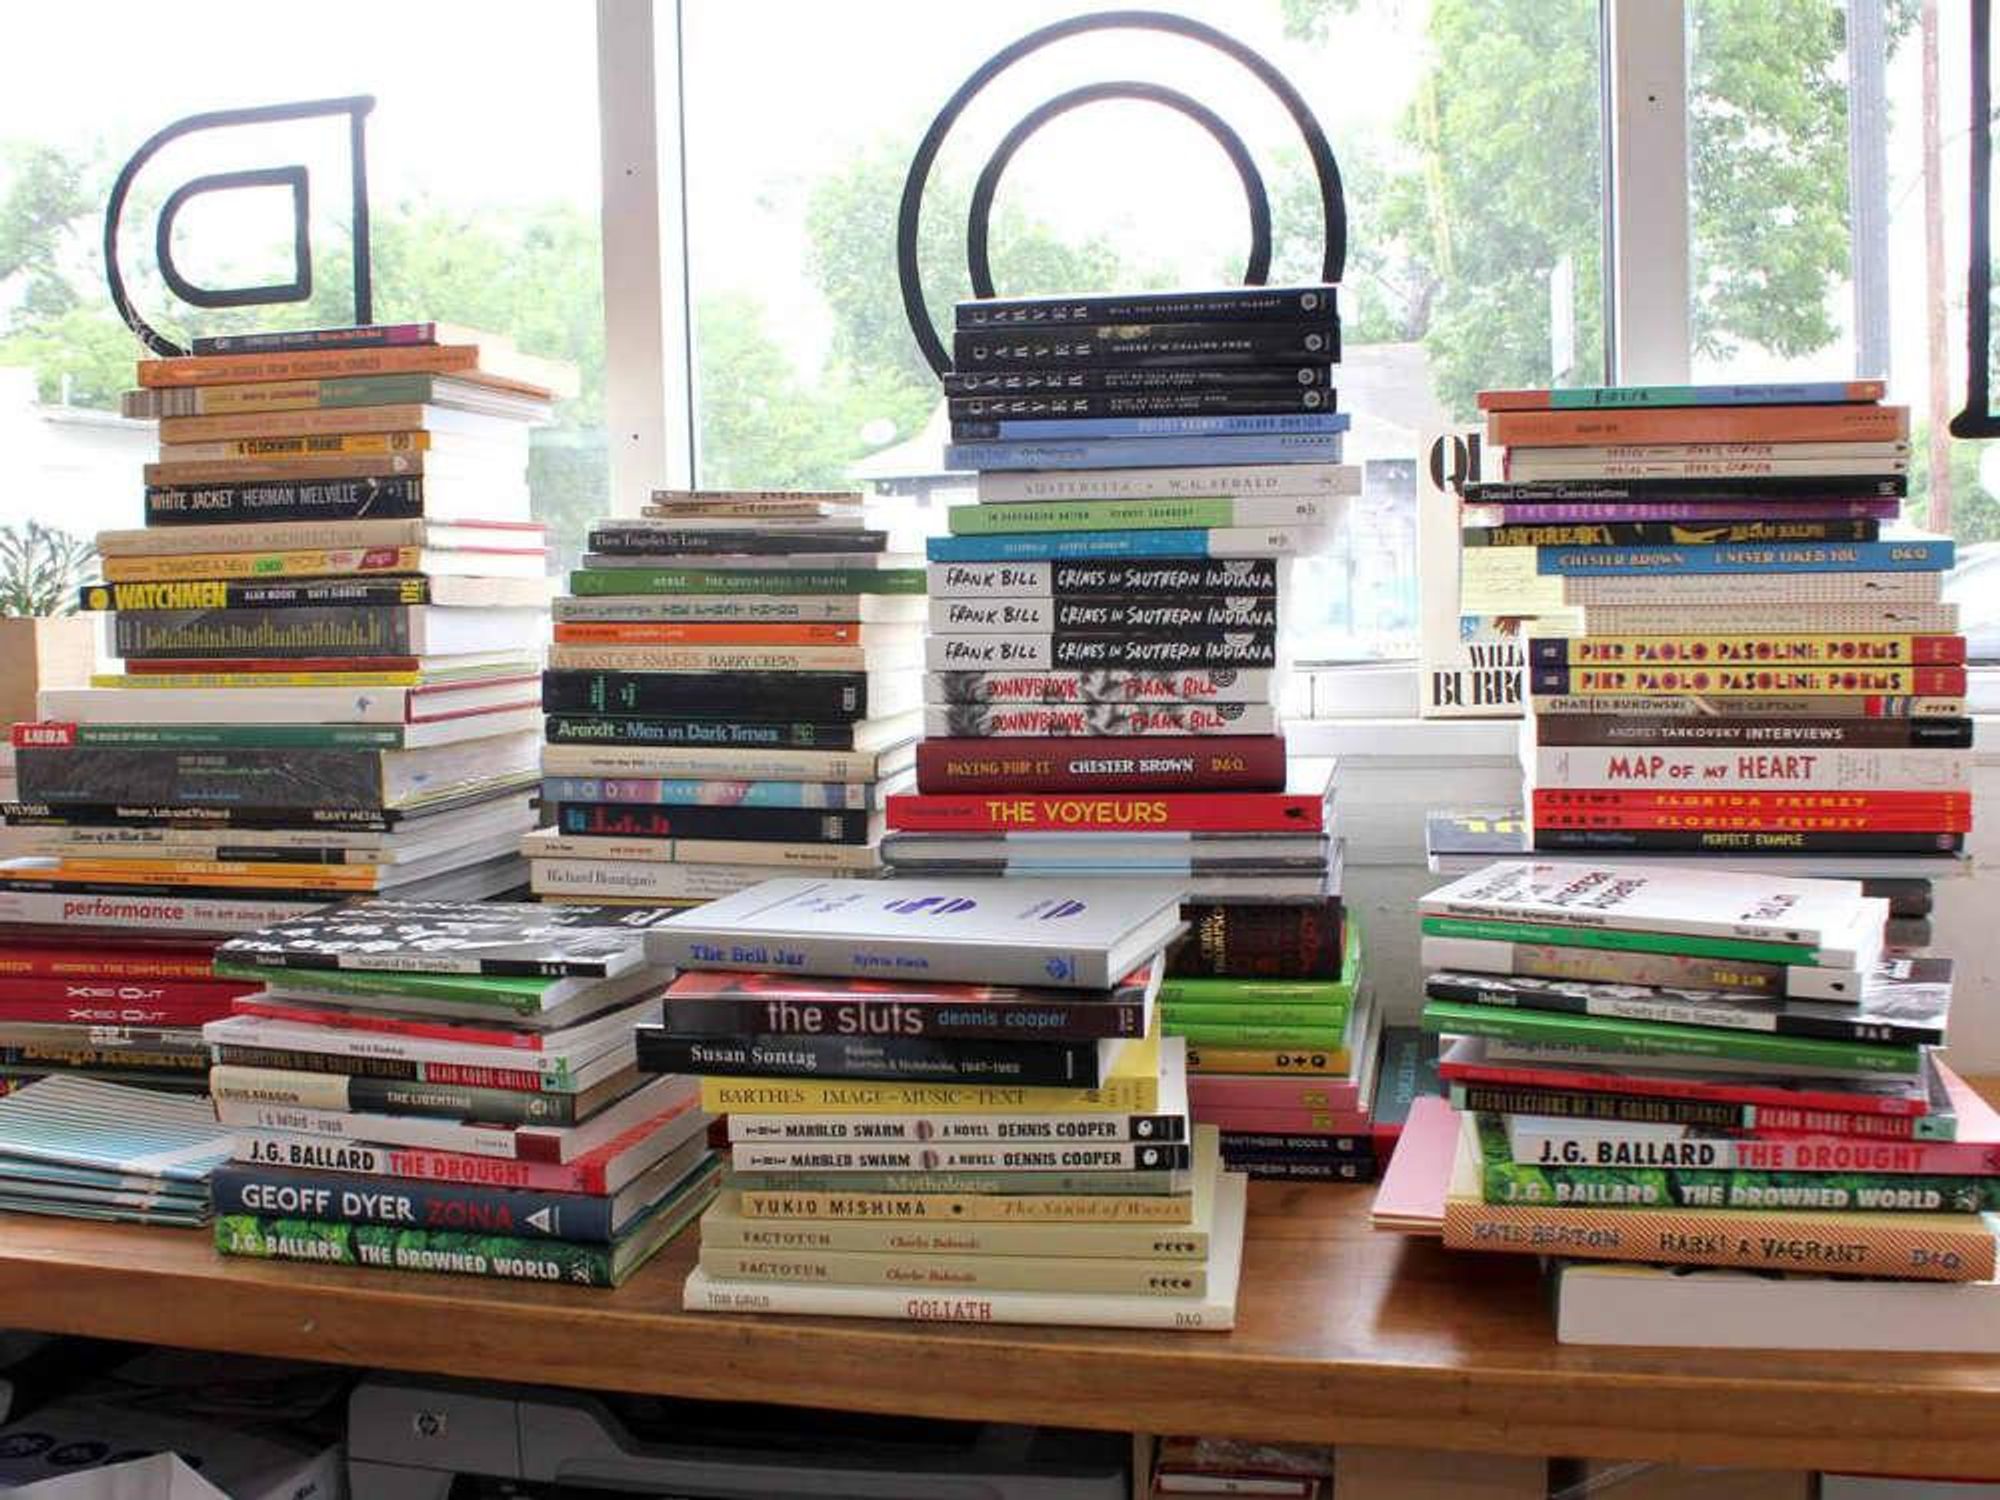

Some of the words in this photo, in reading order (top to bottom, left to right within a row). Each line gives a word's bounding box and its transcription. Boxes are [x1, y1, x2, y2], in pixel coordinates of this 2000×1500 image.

[1112, 343, 1149, 352] WHERE
[1172, 341, 1218, 350] CALLING
[1221, 340, 1252, 349] FROM
[151, 488, 187, 509] WHITE
[192, 489, 233, 508] JACKET
[243, 486, 295, 506] HERMAN
[300, 482, 357, 505] MELVILLE
[1480, 488, 1514, 499] Daniel
[1556, 487, 1629, 499] Conversations
[1515, 504, 1547, 517] THE
[1624, 504, 1691, 516] POLICE
[1493, 526, 1605, 545] DAYBREAK
[1731, 525, 1774, 540] BRIAN
[1776, 525, 1825, 540] RALPH
[1559, 553, 1627, 567] CHESTER
[1630, 553, 1685, 567] BROWN
[1726, 551, 1775, 564] NEVER
[1778, 550, 1826, 564] LIKED
[1828, 549, 1857, 563] YOU
[945, 568, 994, 587] FRANK
[1001, 568, 1038, 585] BILL
[1057, 569, 1105, 586] CRIMES
[1108, 572, 1122, 585] IN
[1124, 568, 1200, 587] SOUTHERN
[1205, 569, 1273, 588] INDIANA
[115, 583, 227, 609] WATCHMEN
[245, 590, 267, 601] ALAN
[949, 604, 998, 624] FRANK
[1003, 604, 1040, 623] BILL
[1059, 605, 1107, 624] CRIMES
[1110, 608, 1123, 622] IN
[1126, 605, 1202, 625] SOUTHERN
[1206, 605, 1275, 625] INDIANA
[945, 641, 994, 661] FRANK
[1000, 641, 1038, 660] BILL
[1057, 642, 1105, 660] CRIMES
[1108, 645, 1122, 659] IN
[1124, 641, 1200, 660] SOUTHERN
[1205, 641, 1273, 661] INDIANA
[1579, 642, 1624, 660] PIER
[1634, 642, 1708, 660] PAOLO
[1717, 642, 1819, 660] PASOLINI:
[1826, 642, 1900, 659] POEMS
[708, 655, 753, 668] HARRY
[986, 677, 1079, 699] DONNYBROOK
[1124, 678, 1179, 696] FRANK
[1182, 676, 1218, 695] BILL
[1580, 672, 1625, 689] PIER
[1635, 672, 1710, 689] PAOLO
[1719, 672, 1820, 689] PASOLINI:
[1828, 672, 1902, 688] POEMS
[1551, 699, 1609, 711] CHARLES
[1611, 699, 1687, 711] BUKOWSKI
[1719, 701, 1744, 711] THE
[1746, 701, 1809, 711] CAPTAIN
[558, 720, 615, 738] Arendt
[626, 721, 665, 739] Men
[668, 723, 684, 739] in
[687, 723, 728, 741] Dark
[730, 724, 779, 742] Times
[991, 712, 1086, 734] DONNYBROOK
[1129, 712, 1185, 729] FRANK
[1190, 711, 1226, 729] BILL
[24, 728, 69, 744] LUBA
[1607, 728, 1657, 739] ANDREI
[1660, 727, 1743, 739] TARKOVSKY
[1745, 726, 1843, 741] INTERVIEWS
[946, 760, 1000, 777] PAYING
[1034, 760, 1051, 775] IT
[1067, 758, 1136, 776] CHESTER
[1138, 757, 1195, 775] BROWN
[1607, 754, 1663, 781] MAP
[1669, 764, 1695, 780] OF
[1703, 764, 1728, 779] MY
[1737, 754, 1817, 781] HEART
[1545, 794, 1624, 806] CREWS
[1654, 796, 1761, 808] FLORIDA
[1774, 796, 1867, 808] FRENZY
[349, 810, 385, 822] METAL
[985, 801, 1036, 824] THE
[1043, 801, 1168, 824] VOYEURS
[1545, 815, 1622, 826] CREWS
[1655, 816, 1762, 828] FLORIDA
[1775, 815, 1868, 828] FRENZY
[1701, 833, 1750, 847] PERFECT
[1755, 833, 1805, 847] EXAMPLE
[63, 897, 185, 920] performance
[1498, 907, 1518, 919] from
[690, 944, 726, 963] The
[731, 944, 769, 963] Bell
[771, 947, 808, 968] Jar
[852, 953, 892, 971] Sylvia
[767, 1001, 829, 1033] the
[838, 1001, 924, 1034] sluts
[937, 1009, 998, 1027] dennis
[1005, 1011, 1067, 1030] cooper
[1672, 1008, 1692, 1021] the
[690, 1044, 749, 1062] Susan
[752, 1046, 817, 1069] Sontag
[387, 1091, 410, 1104] THE
[719, 1087, 805, 1105] BARTHES
[981, 1091, 1026, 1105] TEXT
[1760, 1105, 1796, 1128] ALAIN
[785, 1124, 848, 1138] MARBLED
[852, 1124, 905, 1138] SWARM
[942, 1126, 952, 1137] A
[953, 1126, 989, 1137] NOVEL
[997, 1123, 1052, 1138] DENNIS
[1056, 1123, 1117, 1138] COOPER
[250, 1140, 284, 1163] J.G.
[289, 1144, 375, 1172] BALLARD
[389, 1153, 426, 1176] THE
[433, 1156, 530, 1185] DROUGHT
[790, 1154, 853, 1168] MARBLED
[859, 1154, 911, 1168] SWARM
[947, 1156, 956, 1167] A
[958, 1156, 995, 1167] NOVEL
[1003, 1153, 1057, 1168] DENNIS
[1061, 1153, 1122, 1168] COOPER
[1538, 1140, 1587, 1164] J.G.
[1598, 1142, 1715, 1166] BALLARD
[1736, 1144, 1789, 1168] THE
[1797, 1145, 1925, 1170] DROUGHT
[241, 1184, 333, 1214] GEOFF
[341, 1192, 415, 1222] DYER
[426, 1199, 514, 1229] ZONA
[1556, 1184, 1659, 1203] BALLARD
[1682, 1186, 1724, 1206] THE
[1730, 1186, 1848, 1208] DROWNED
[1857, 1187, 1940, 1209] WORLD
[753, 1199, 818, 1215] YUKIO
[828, 1200, 927, 1217] MISHIMA
[1003, 1200, 1035, 1216] The
[1127, 1201, 1183, 1217] Waves
[742, 1231, 831, 1246] FACTOTUM
[889, 1235, 929, 1250] Charles
[931, 1237, 980, 1251] Bukowski
[1473, 1221, 1528, 1242] KATE
[1531, 1223, 1620, 1247] BEATON
[1659, 1232, 1728, 1255] HARK!
[1760, 1238, 1870, 1263] VAGRANT
[266, 1237, 343, 1259] BALLARD
[359, 1244, 391, 1264] THE
[396, 1246, 487, 1275] DROWNED
[493, 1257, 560, 1280] WORLD
[739, 1263, 827, 1278] FACTOTUM
[885, 1268, 926, 1283] Charles
[928, 1269, 977, 1283] Bukowski
[707, 1294, 732, 1307] TOM
[907, 1300, 992, 1322] GOLIATH
